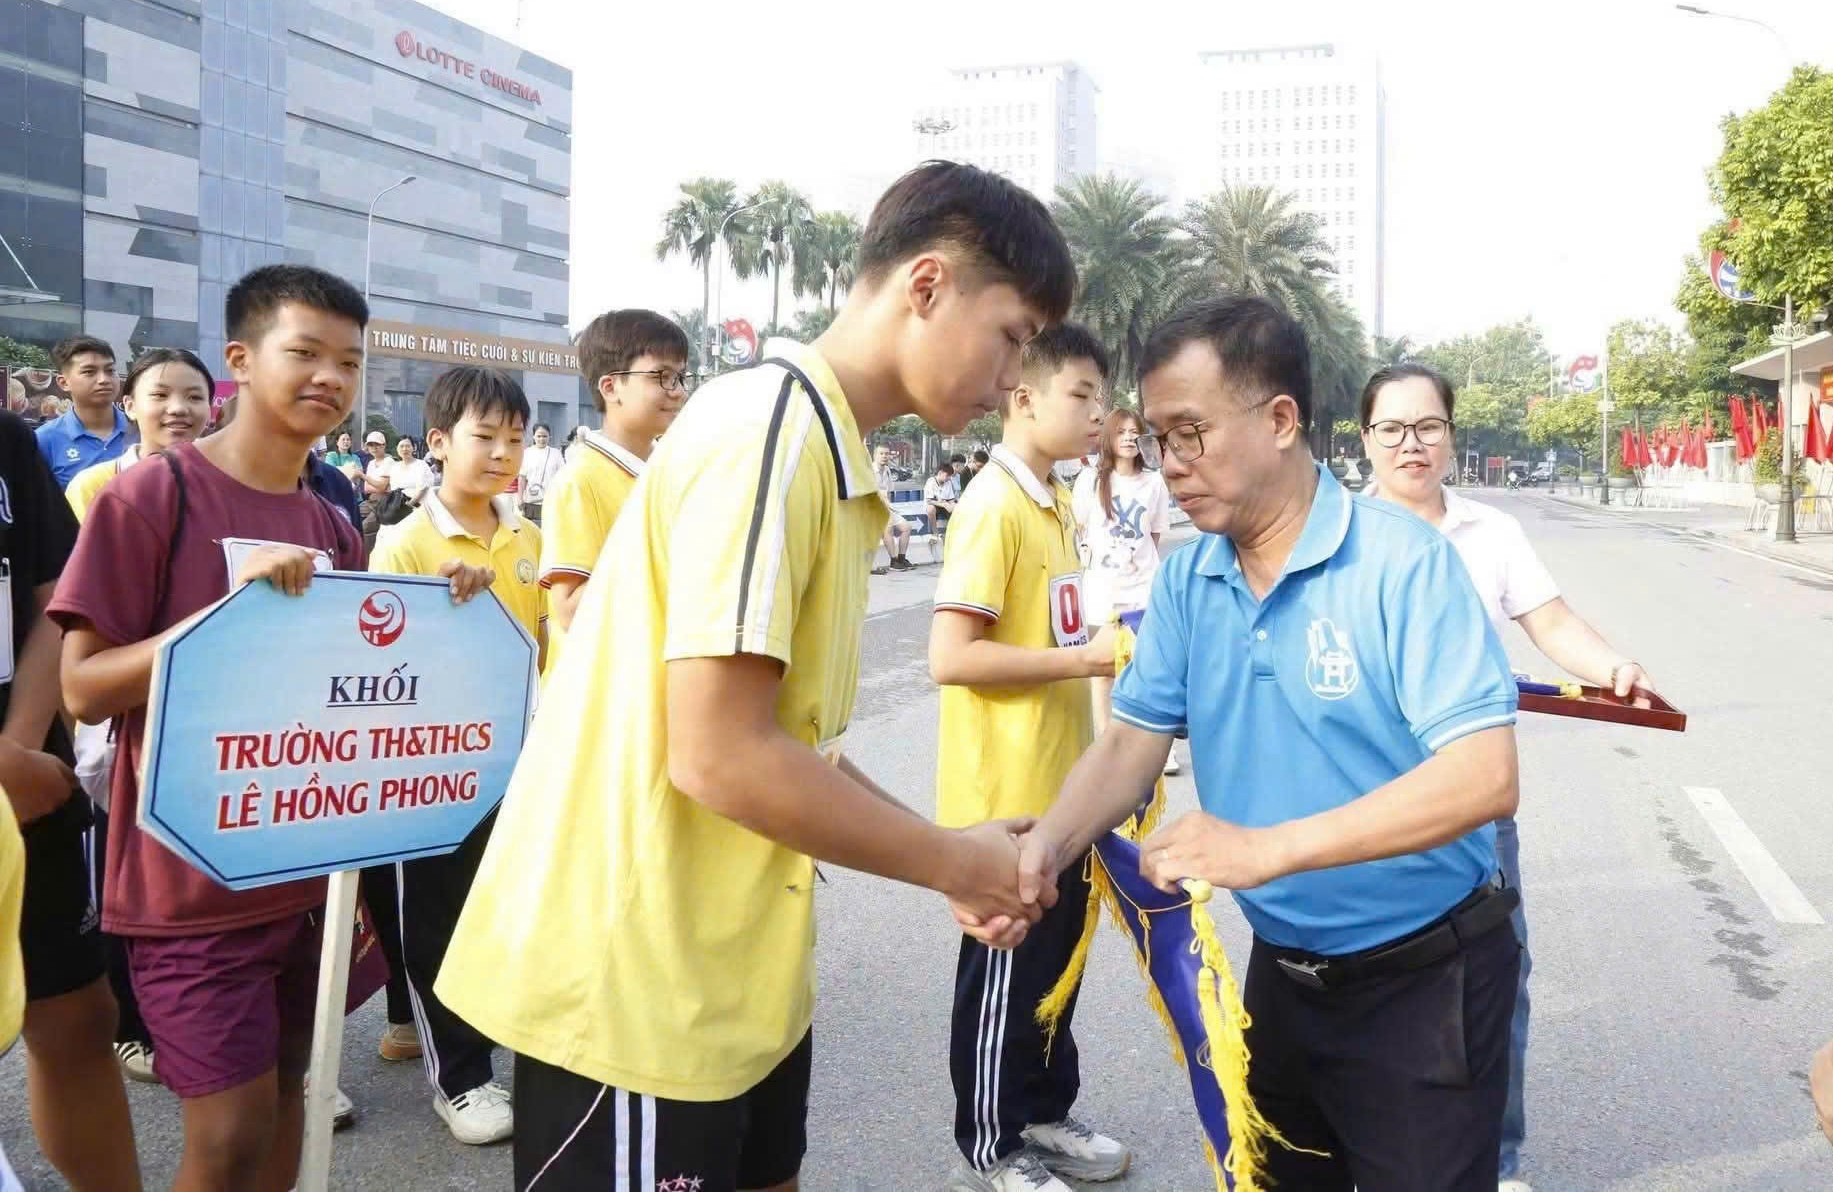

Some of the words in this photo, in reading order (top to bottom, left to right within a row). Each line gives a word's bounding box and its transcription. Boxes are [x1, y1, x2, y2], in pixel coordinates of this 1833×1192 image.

[416, 41, 475, 79] LOTTE
[480, 68, 542, 106] CINEMA
[372, 330, 416, 350] TRUNG
[421, 333, 447, 354] TÂM
[452, 337, 477, 361] TIỆC
[511, 347, 518, 363] &
[539, 348, 561, 370] KIỆN
[1059, 583, 1083, 634] 0
[328, 662, 420, 704] KHỐI
[216, 722, 357, 770] TRƯỜNG
[368, 722, 492, 760] TH&THCS
[217, 782, 262, 830] LÊ
[272, 771, 369, 824] HỒNG
[379, 770, 478, 811] PHONG
